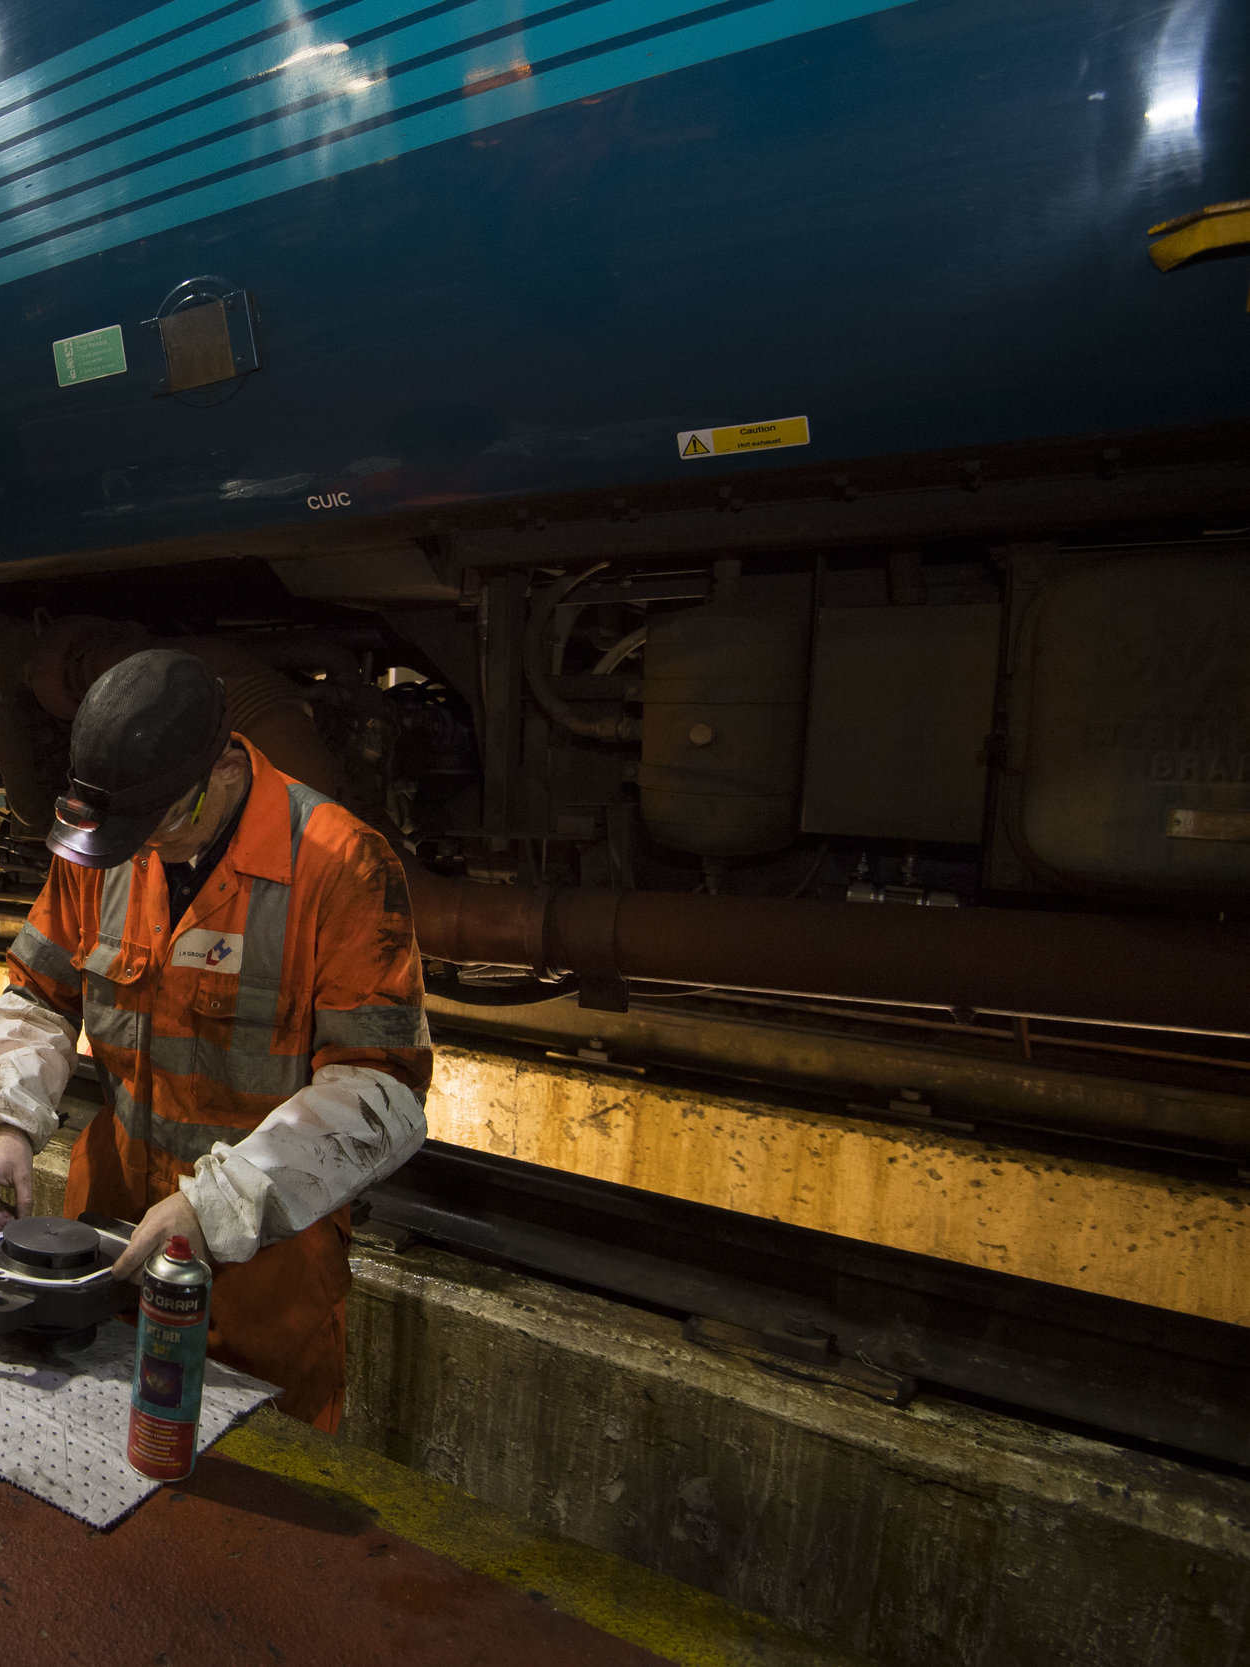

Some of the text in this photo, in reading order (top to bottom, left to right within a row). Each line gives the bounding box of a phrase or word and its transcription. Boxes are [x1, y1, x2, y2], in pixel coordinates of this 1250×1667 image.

[740, 425, 776, 436] Caution
[738, 438, 782, 449] Hot exhaust
[307, 491, 351, 510] CUIC
[187, 951, 206, 959] GROUP
